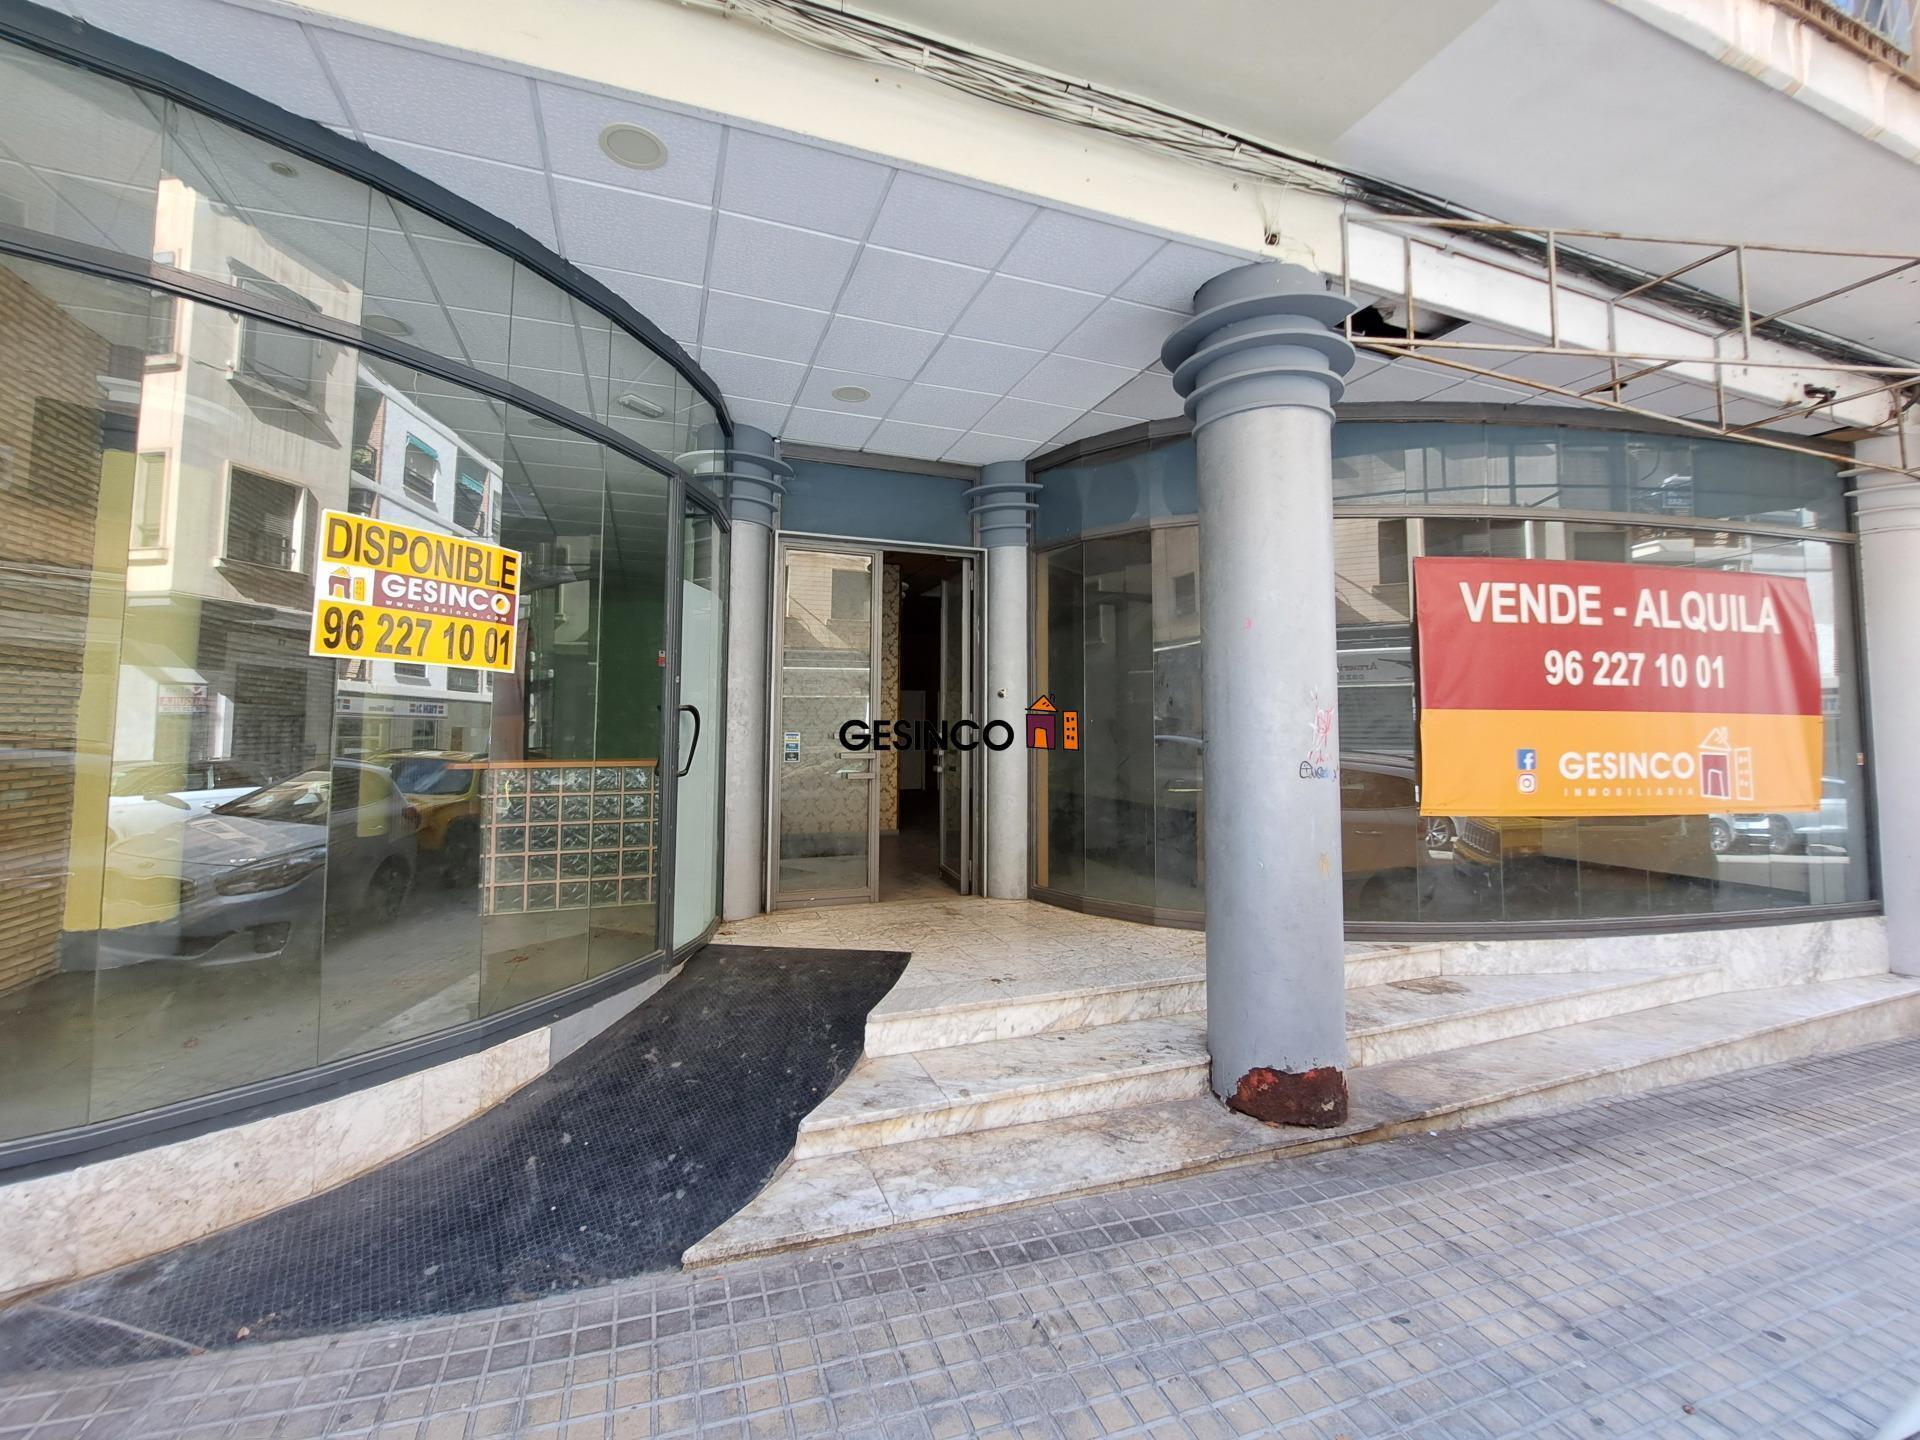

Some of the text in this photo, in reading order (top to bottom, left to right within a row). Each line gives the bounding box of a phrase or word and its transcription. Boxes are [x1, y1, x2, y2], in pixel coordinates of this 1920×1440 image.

[326, 517, 517, 591] DISPONIBLE
[381, 574, 511, 615] GESINCO
[385, 600, 508, 622] www.gesinco.com
[1459, 581, 1604, 626] VENDE
[1634, 588, 1781, 635] ALQUILA
[323, 606, 510, 665] 96 227 10 01
[1544, 649, 1725, 689] 96 227 10 01
[1558, 751, 1695, 779] GESINCO
[1563, 786, 1694, 798] INMOBILIARIA
